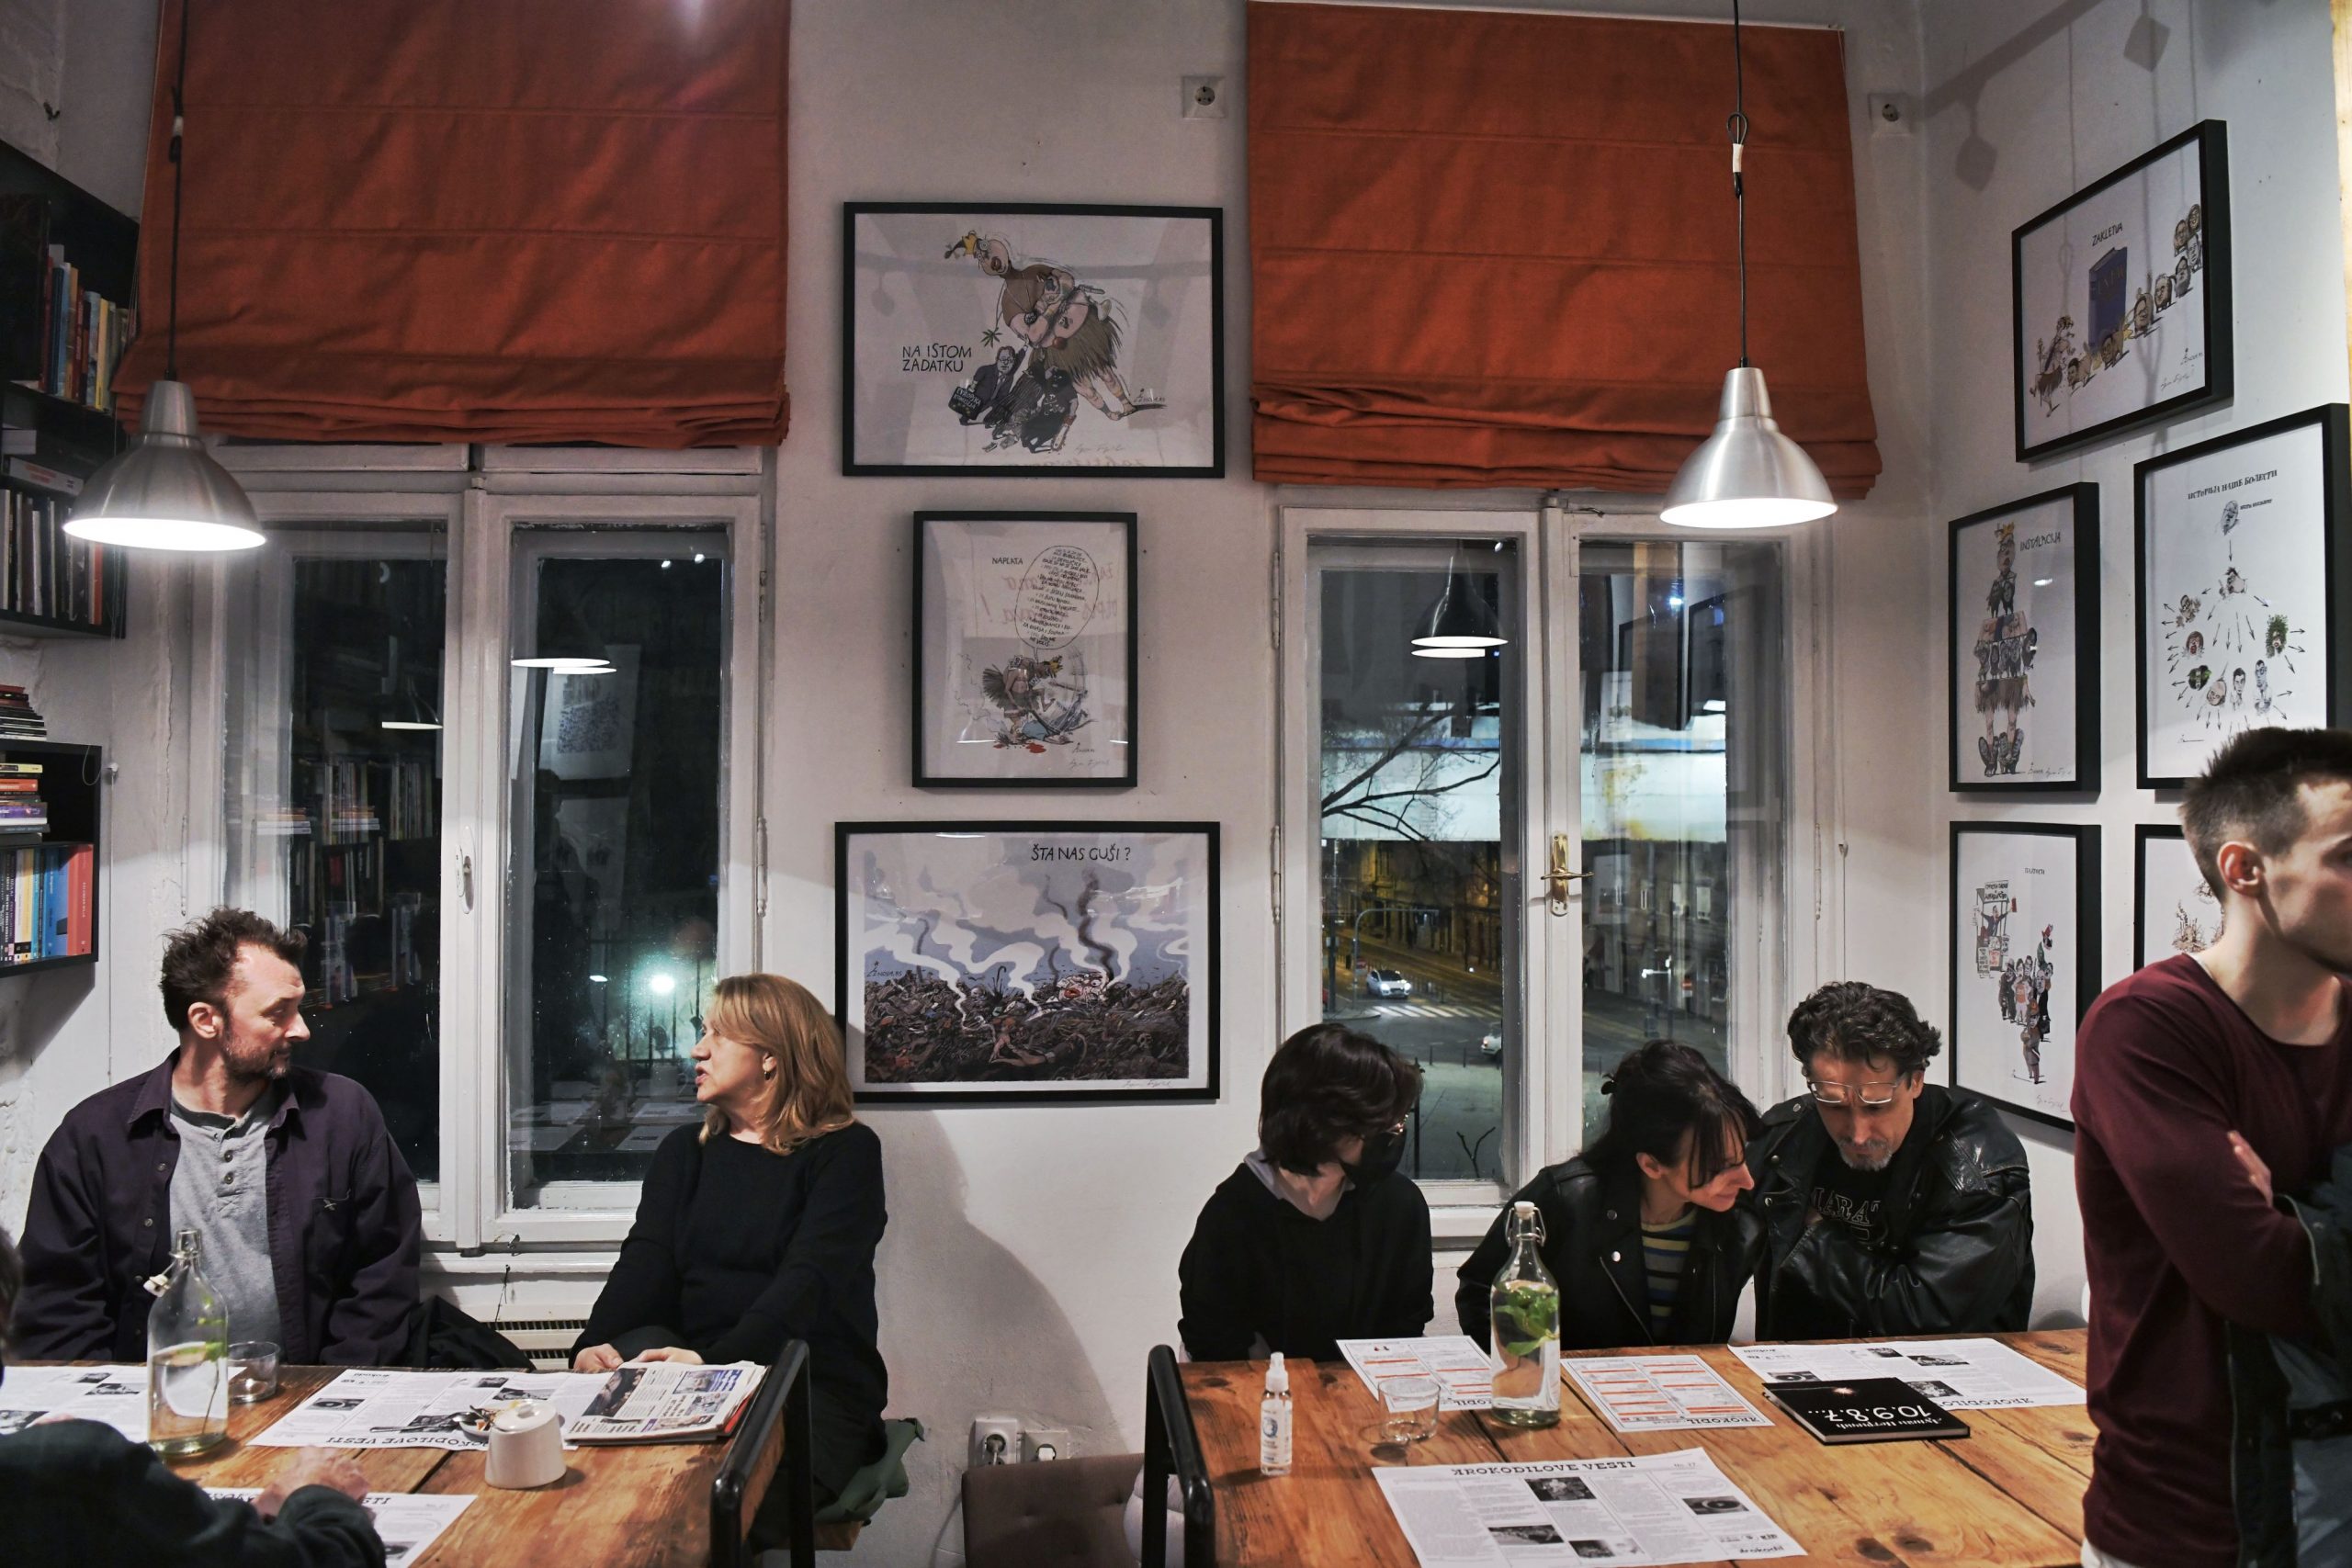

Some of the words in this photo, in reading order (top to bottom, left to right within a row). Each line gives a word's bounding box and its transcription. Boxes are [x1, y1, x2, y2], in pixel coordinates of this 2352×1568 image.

[2092, 222, 2123, 246] ZAKLETVA
[902, 345, 921, 358] NA
[927, 343, 972, 358] ISTOM
[902, 358, 964, 373] ZADATKU
[2020, 531, 2061, 552] INSTALACIJA
[992, 557, 1023, 565] NAPLATA
[1031, 843, 1054, 861] ŠTA
[1058, 847, 1085, 861] NAS
[1089, 843, 1119, 862] GUŠI
[1125, 847, 1131, 861] ?
[1939, 1398, 2034, 1406] KROKODILO
[382, 1438, 489, 1447] OKODILOVE
[1452, 1464, 1579, 1475] KROKODILOVE
[1582, 1461, 1636, 1471] VESTI
